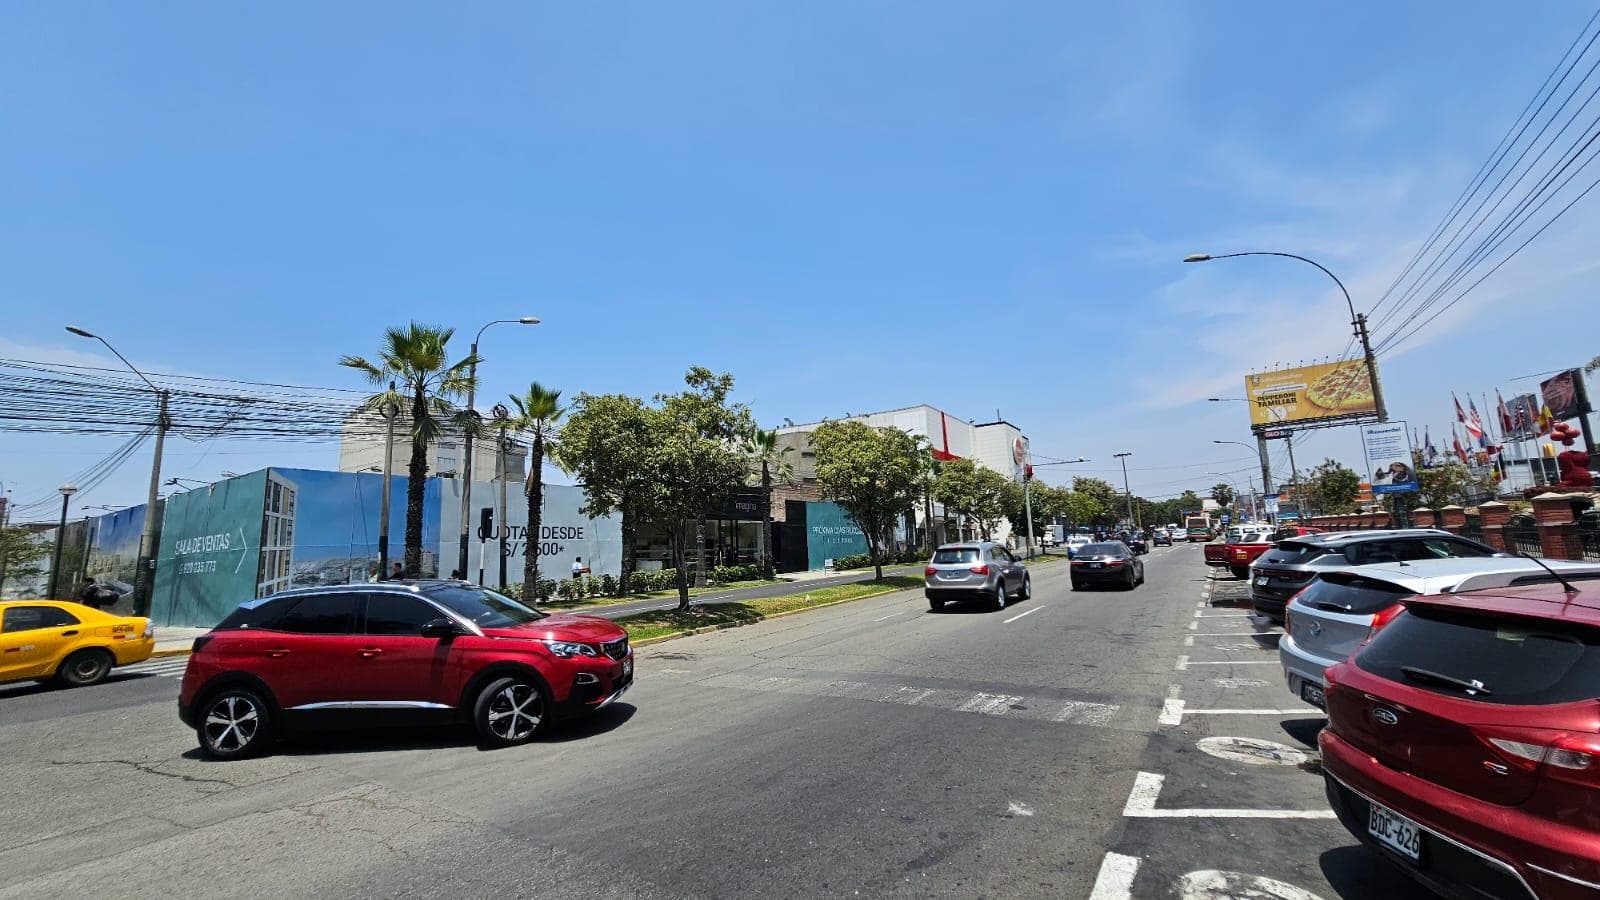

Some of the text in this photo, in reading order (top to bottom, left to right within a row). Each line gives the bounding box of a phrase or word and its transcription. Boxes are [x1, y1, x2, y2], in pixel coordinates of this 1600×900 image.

[1257, 392, 1296, 402] PEPPERONI
[1257, 398, 1297, 408] FAMILIAR
[542, 526, 584, 540] DESDE
[175, 533, 231, 555] SALA DE VENTAS
[1371, 811, 1419, 854] BDC-626
